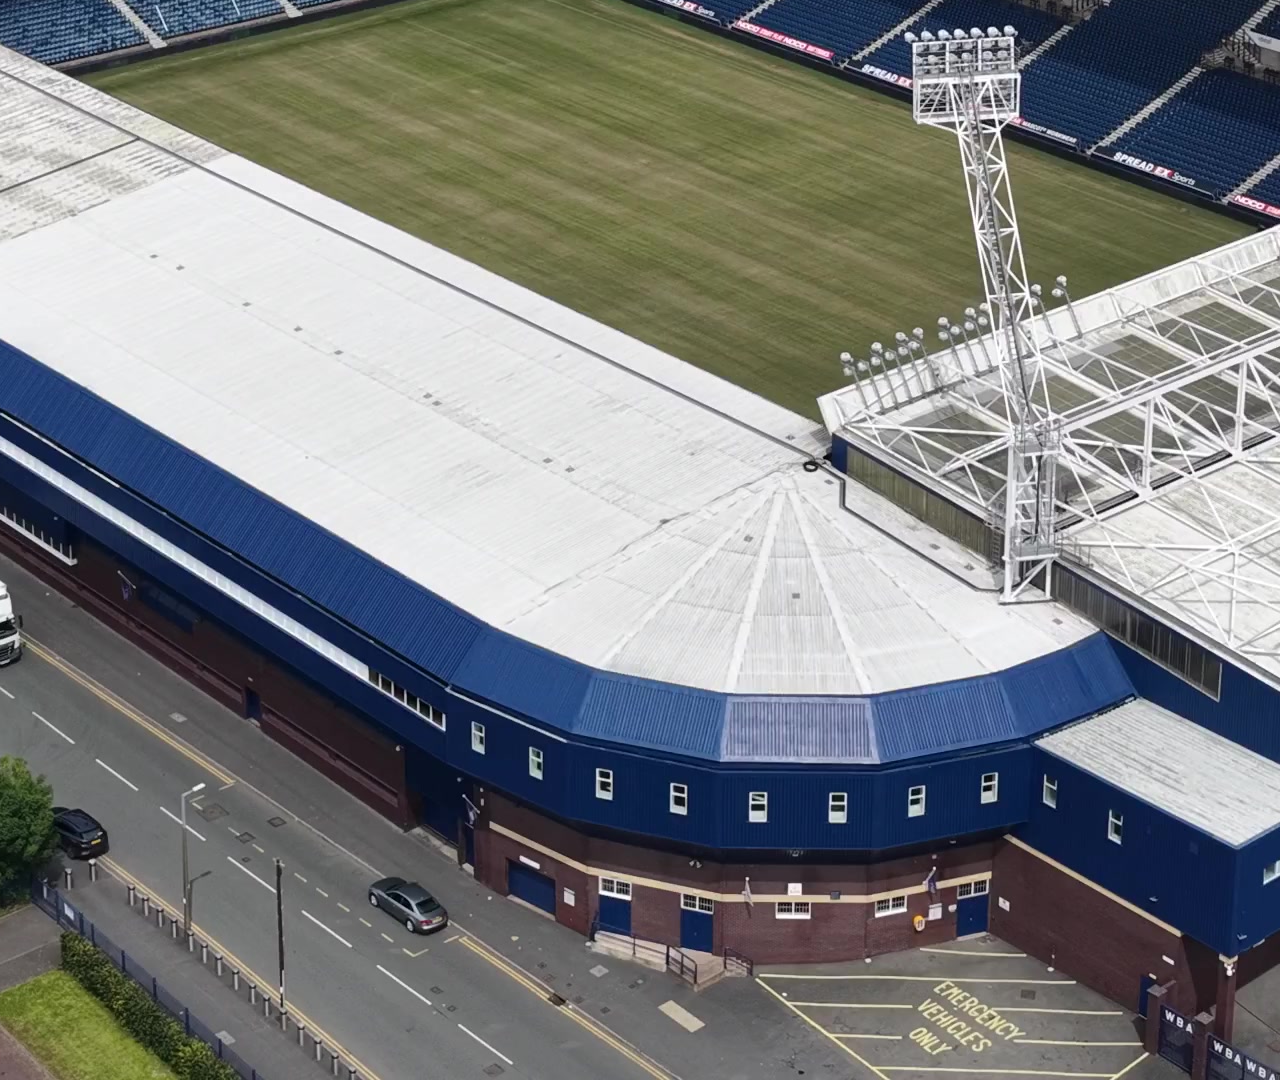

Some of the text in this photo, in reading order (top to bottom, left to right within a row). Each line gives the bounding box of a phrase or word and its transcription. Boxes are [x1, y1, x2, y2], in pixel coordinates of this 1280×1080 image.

[1113, 151, 1154, 172] SPREAD
[1170, 171, 1196, 186] Sports
[1234, 194, 1266, 210] NOCO
[933, 980, 1026, 1040] EMERGENCY
[1164, 1009, 1193, 1034] WBA
[918, 998, 992, 1052] VEHICLES
[909, 1027, 953, 1055] ONLY
[1213, 1040, 1242, 1066] WBA
[1245, 1059, 1276, 1080] WBA
